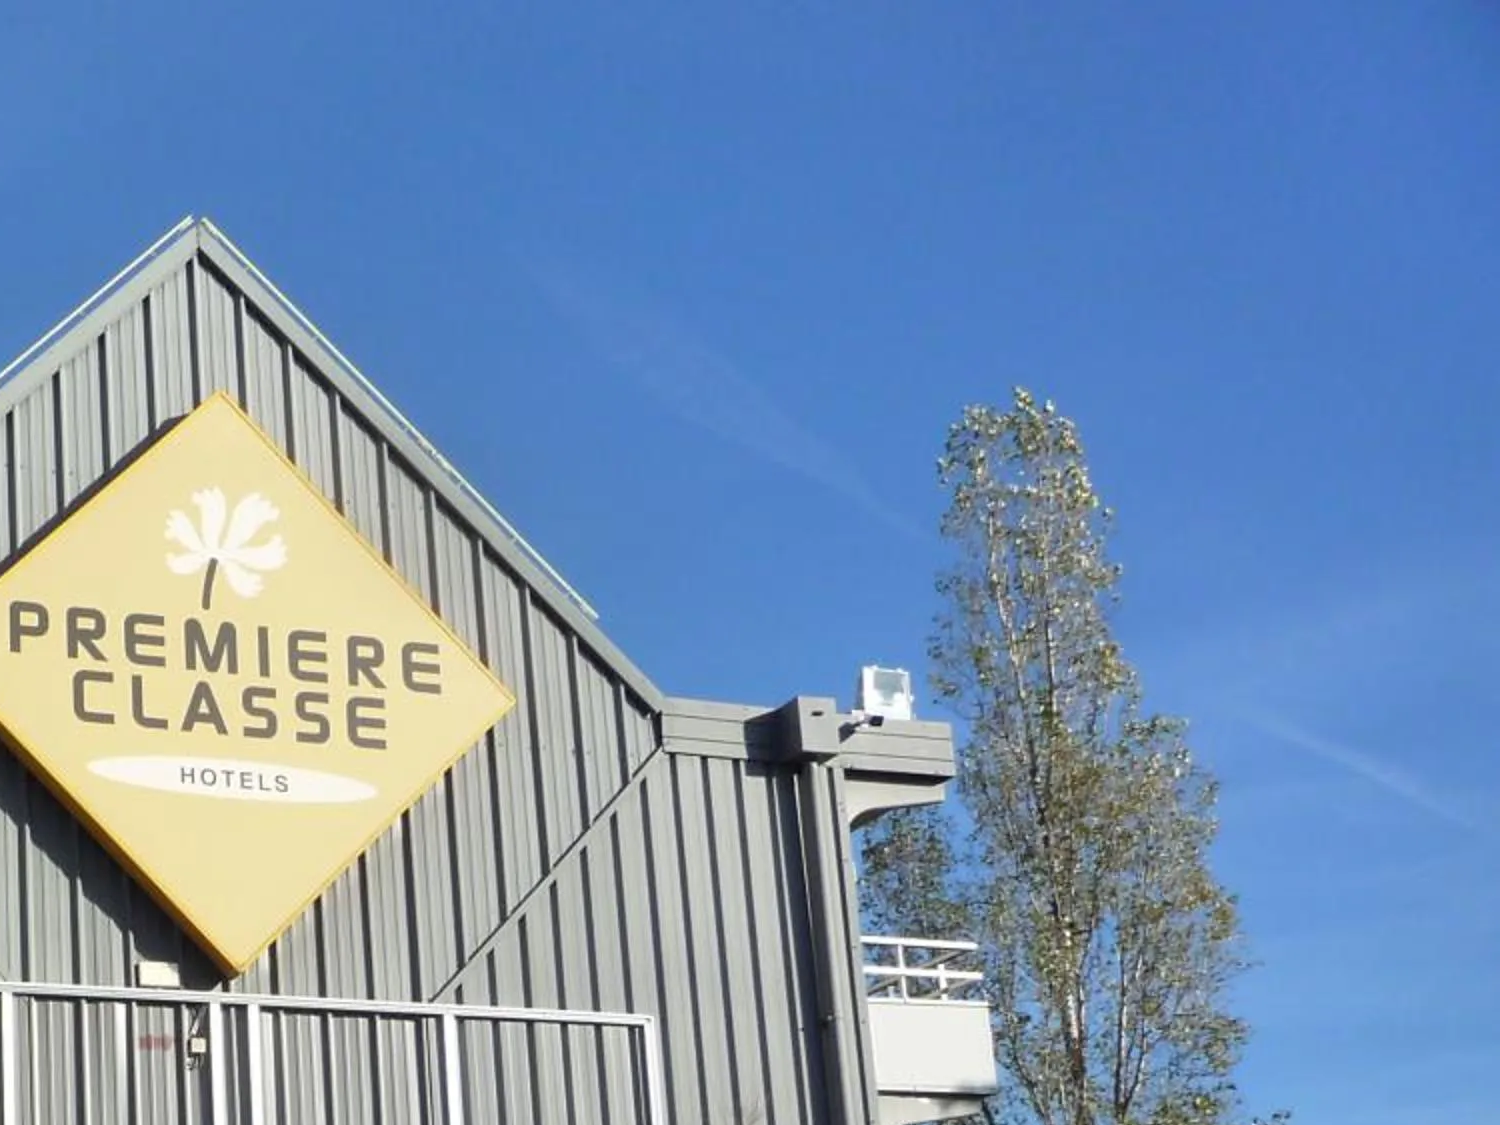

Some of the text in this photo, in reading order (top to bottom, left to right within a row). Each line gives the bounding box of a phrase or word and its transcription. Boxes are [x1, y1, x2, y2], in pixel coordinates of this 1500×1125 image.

[8, 600, 442, 695] PREMIERE
[72, 669, 388, 750] CLASSE
[179, 765, 290, 794] HOTELS
